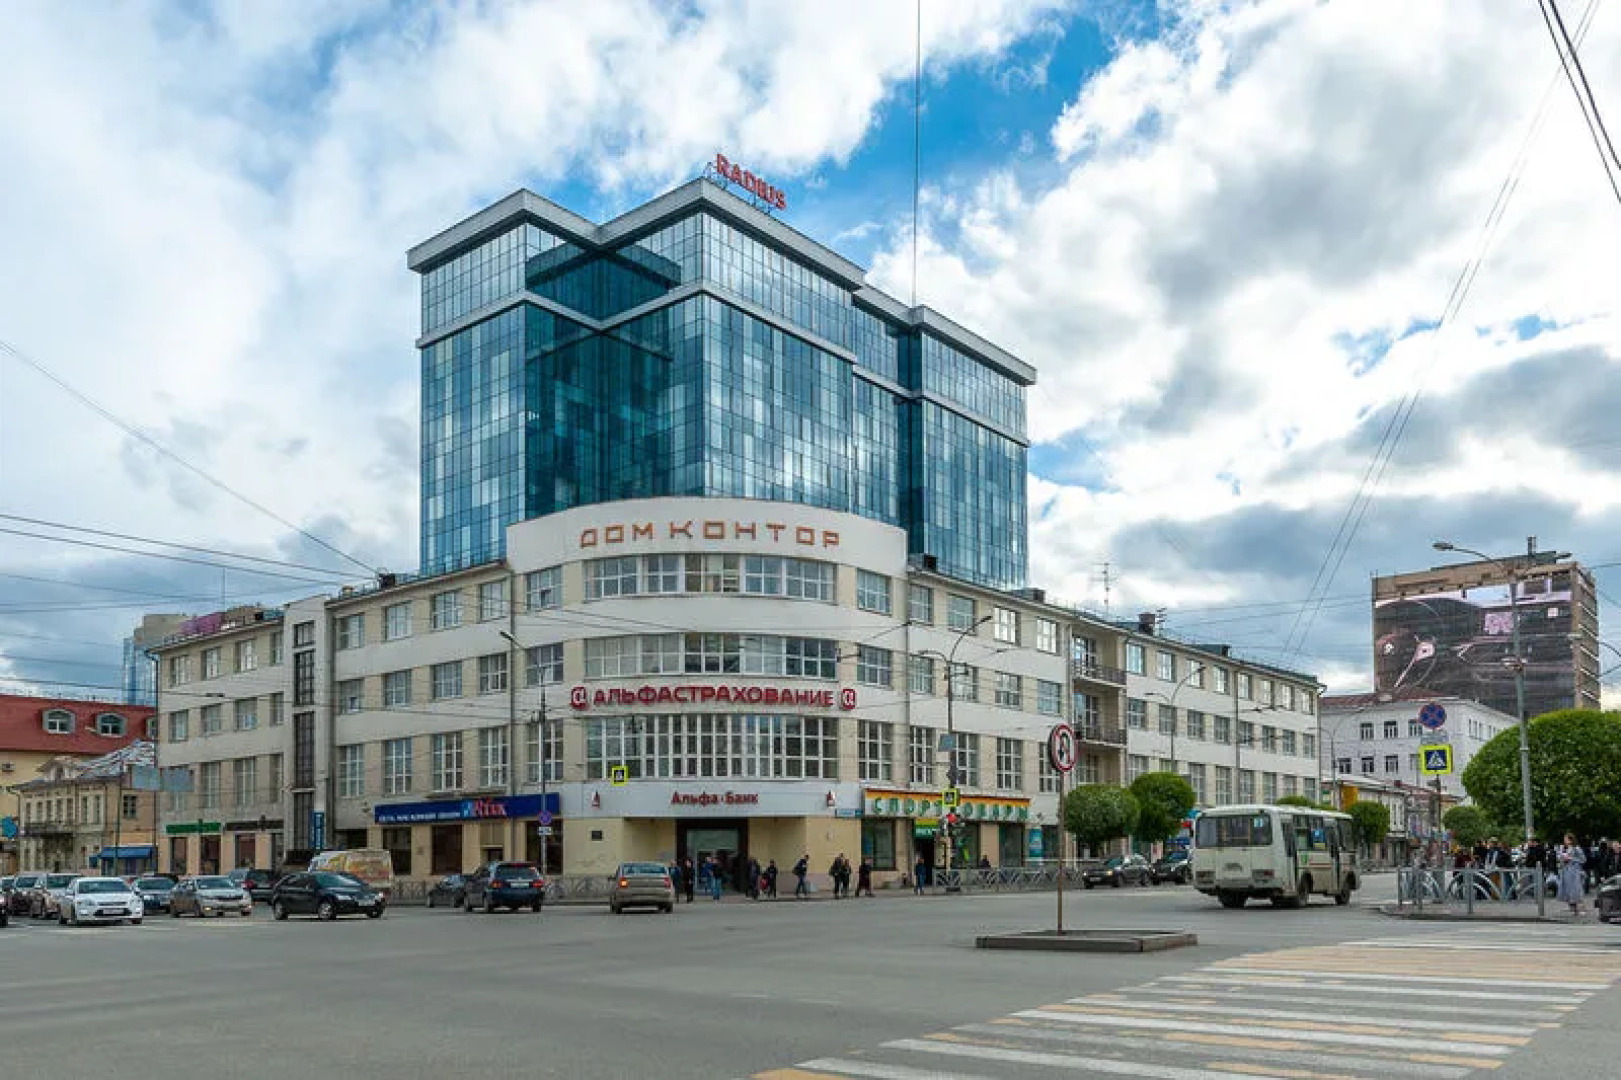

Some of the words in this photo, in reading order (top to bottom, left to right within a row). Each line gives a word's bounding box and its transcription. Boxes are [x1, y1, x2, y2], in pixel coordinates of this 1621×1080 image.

[717, 153, 786, 210] RADIUS
[580, 522, 653, 549] ДОМ
[670, 520, 839, 547] КОНТОР
[594, 685, 834, 707] АЛЬФАСТРАХОВАНИЕ
[874, 798, 1028, 820] СПОРТОВАРЫ
